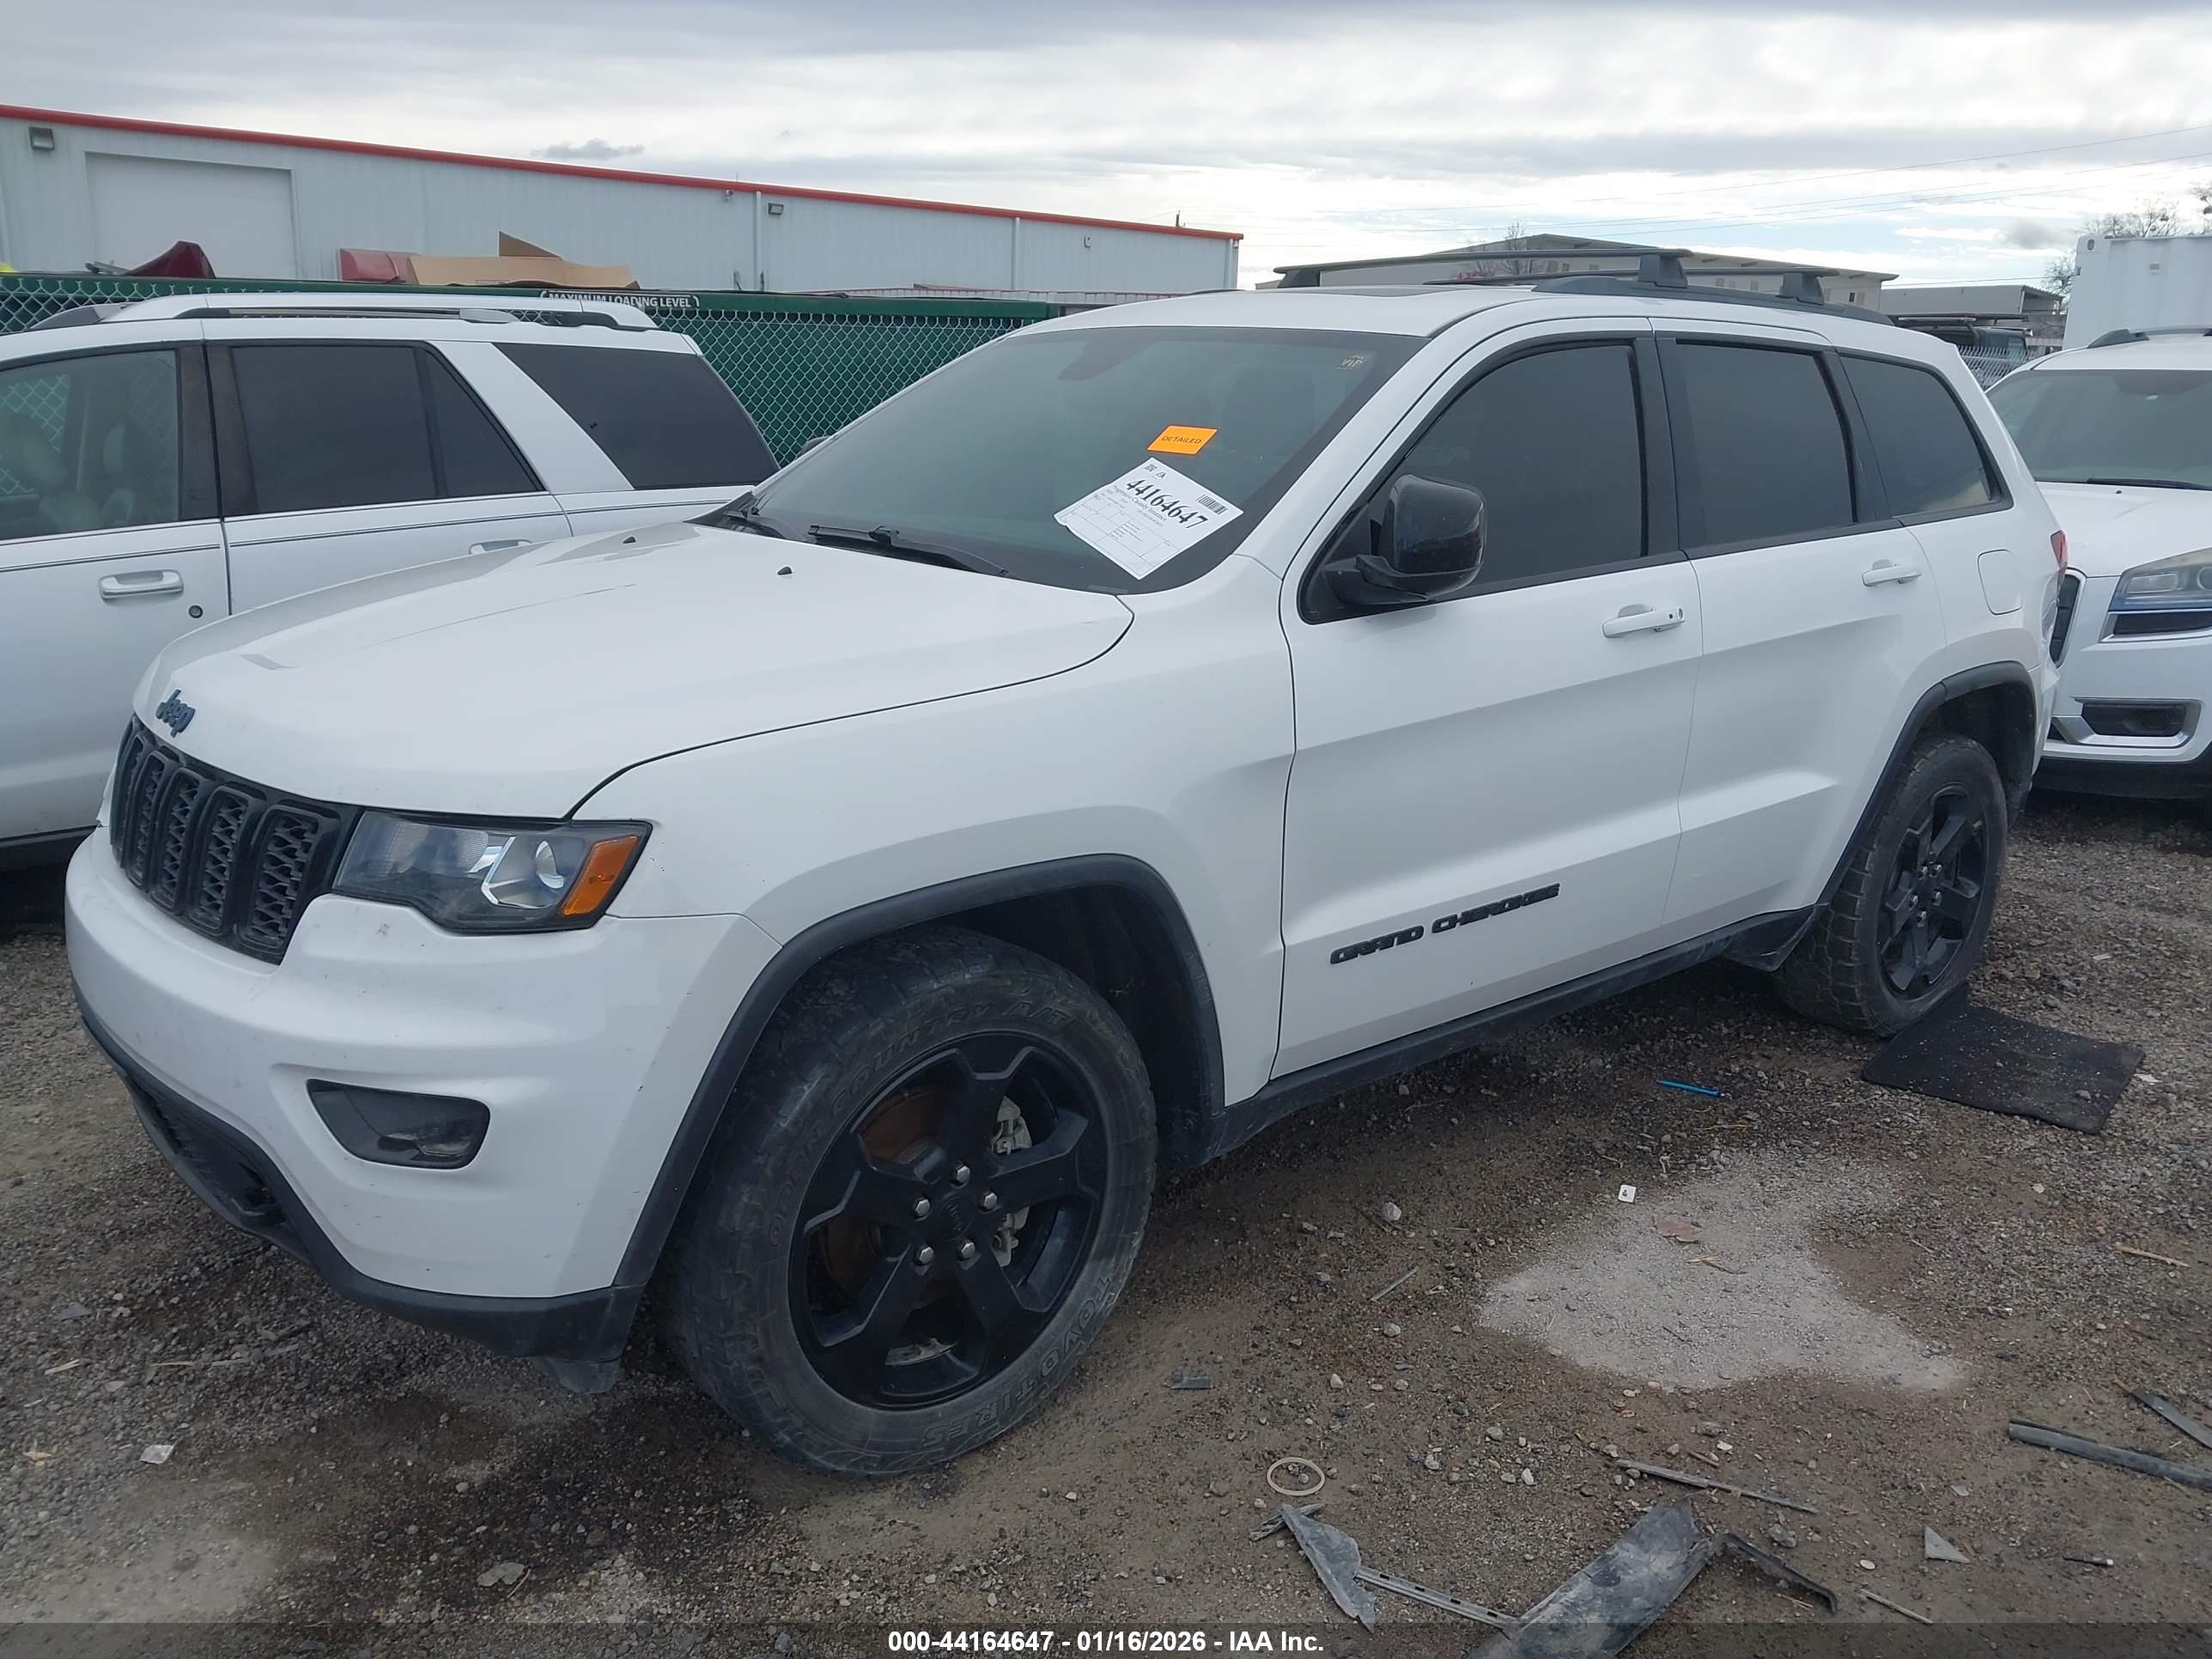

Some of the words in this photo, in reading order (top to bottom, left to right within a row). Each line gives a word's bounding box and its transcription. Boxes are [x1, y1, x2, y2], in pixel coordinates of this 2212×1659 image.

[549, 293, 606, 302] MAXIMUM
[609, 295, 658, 307] LOADING
[659, 297, 691, 307] LEVEL
[1162, 435, 1202, 444] DETAILED
[1127, 479, 1208, 529] 44164647
[155, 689, 196, 738] Jeep
[1330, 925, 1425, 965] GRAND
[1431, 883, 1560, 933] CHEROKEE
